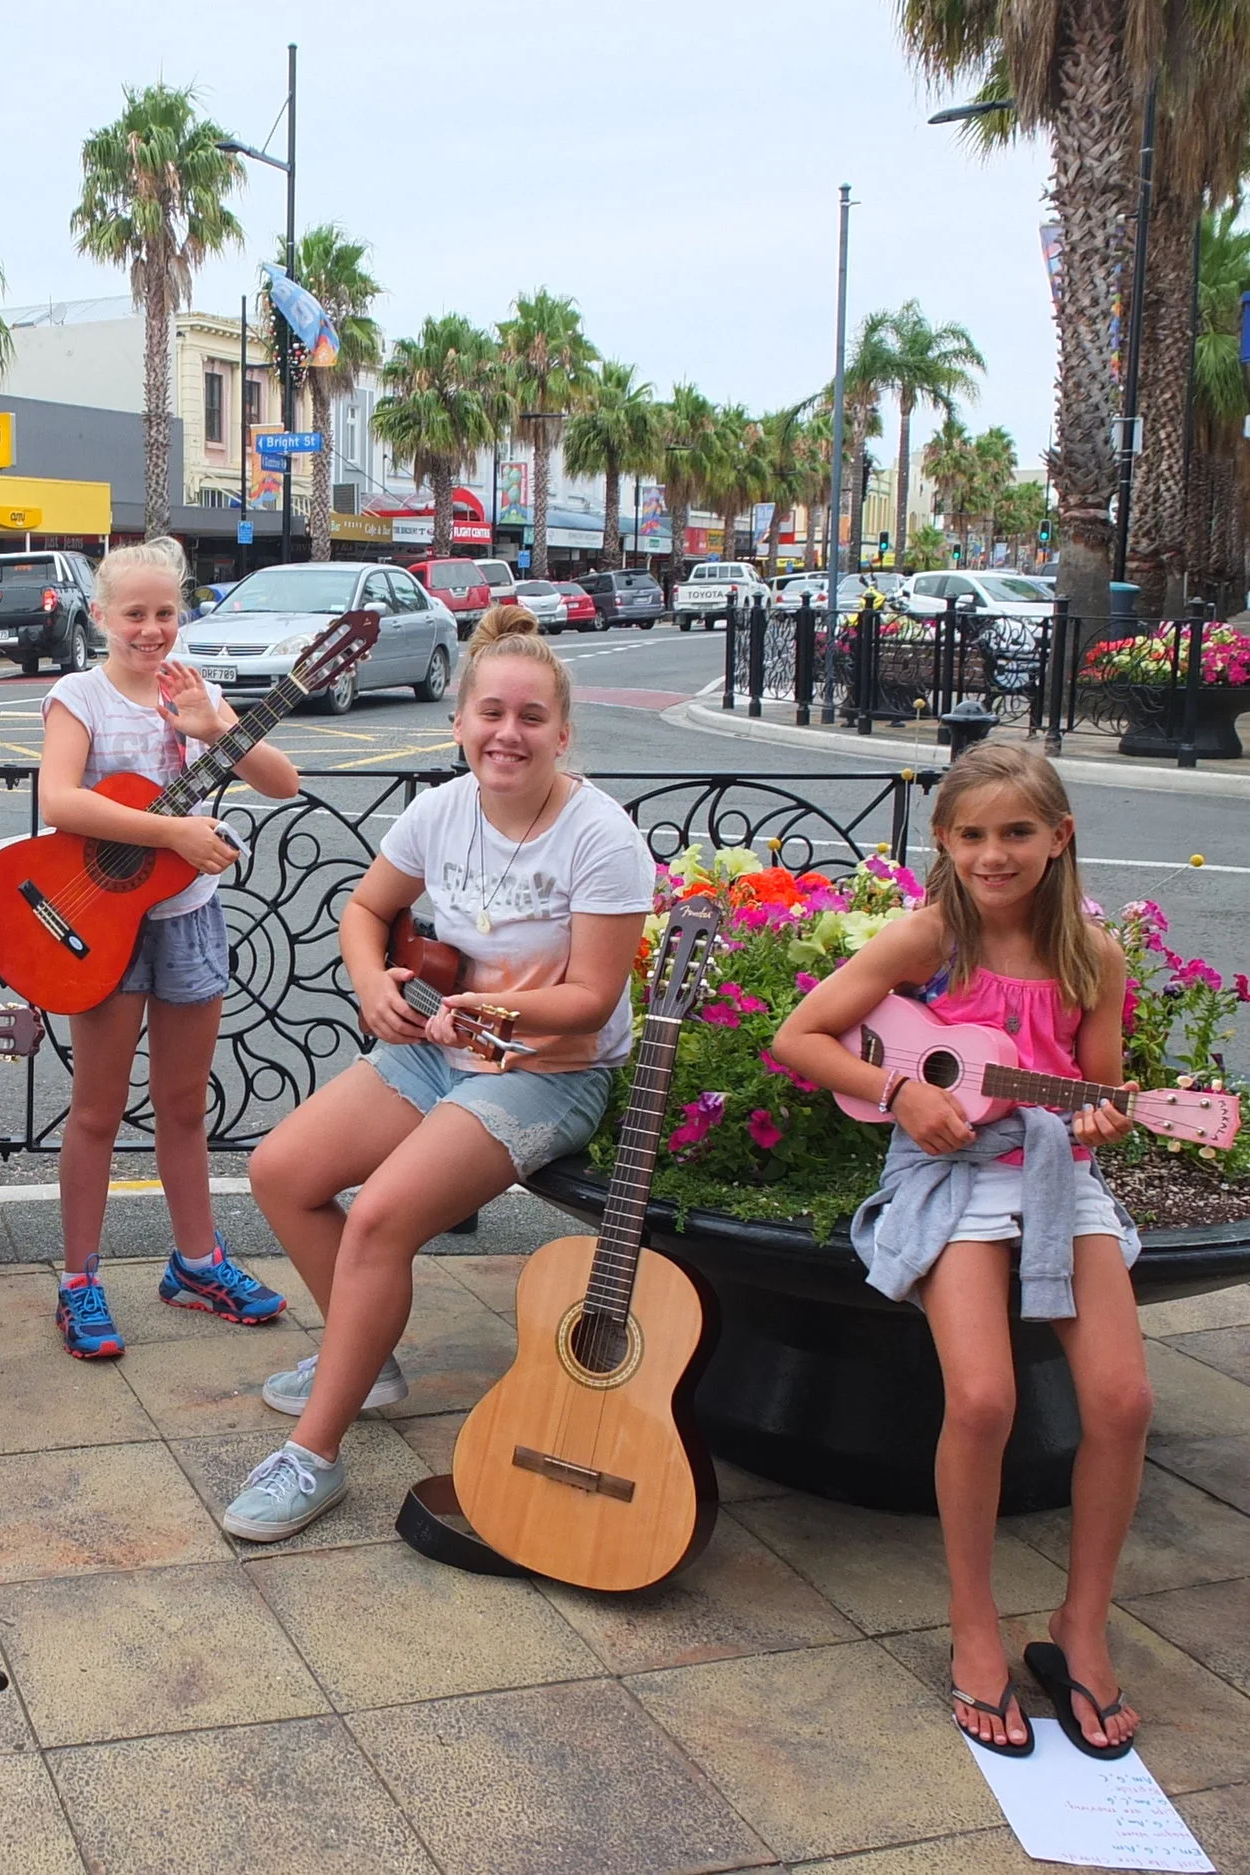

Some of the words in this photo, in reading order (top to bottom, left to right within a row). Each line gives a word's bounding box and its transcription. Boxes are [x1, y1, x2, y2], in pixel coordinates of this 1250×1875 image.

[266, 435, 299, 450] Bright
[303, 435, 315, 447] St
[10, 510, 26, 522] ami
[687, 590, 724, 599] TOYOTA
[201, 667, 235, 681] DRF709
[679, 904, 712, 919] Fender
[1210, 1099, 1230, 1142] MAKALA
